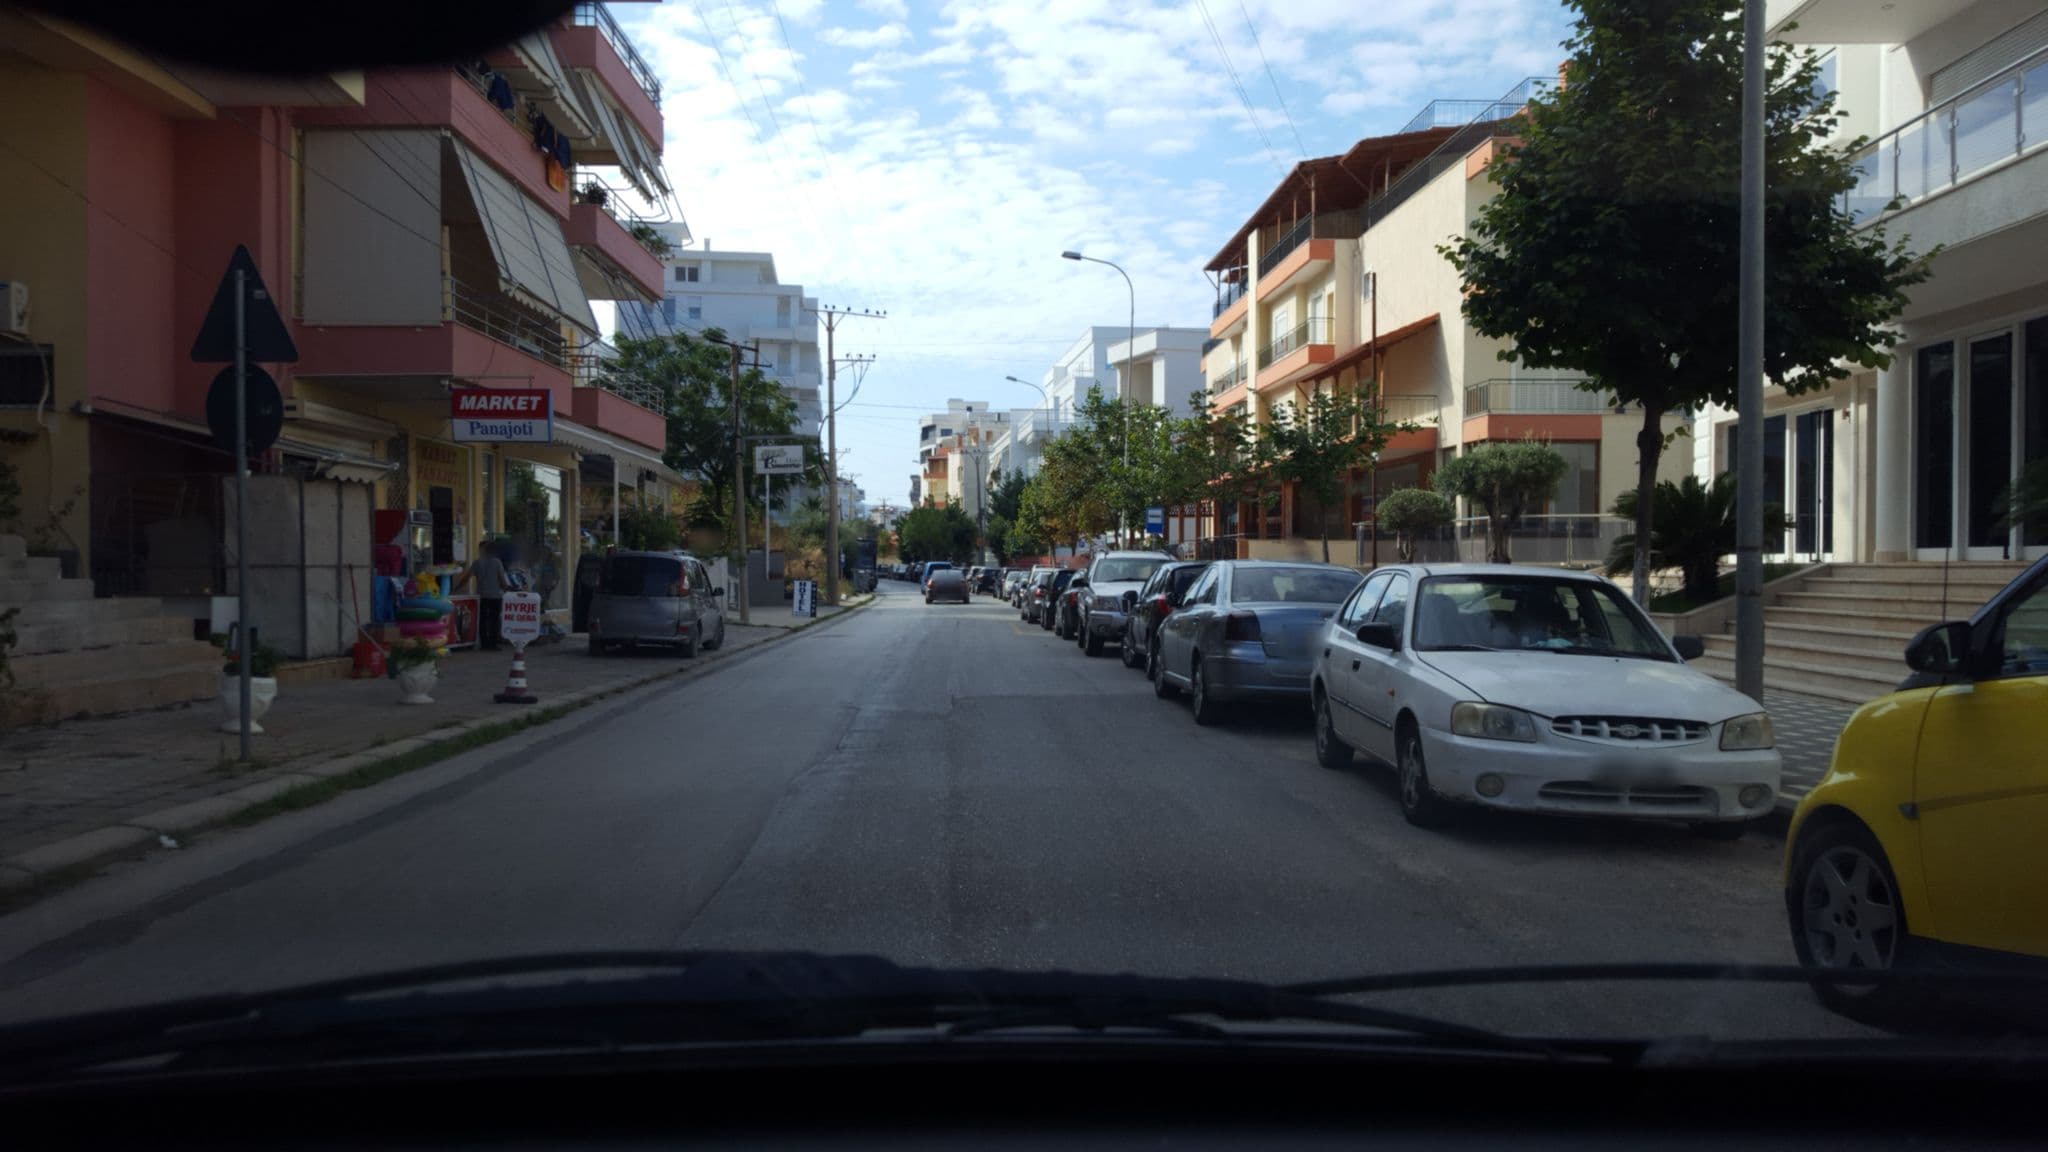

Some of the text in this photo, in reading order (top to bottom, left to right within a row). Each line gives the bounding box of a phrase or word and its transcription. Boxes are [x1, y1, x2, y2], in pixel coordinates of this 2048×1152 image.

[459, 395, 542, 410] MARKET
[469, 421, 533, 439] Panajoti
[798, 581, 807, 612] HOTEL
[505, 602, 536, 613] HYRJE
